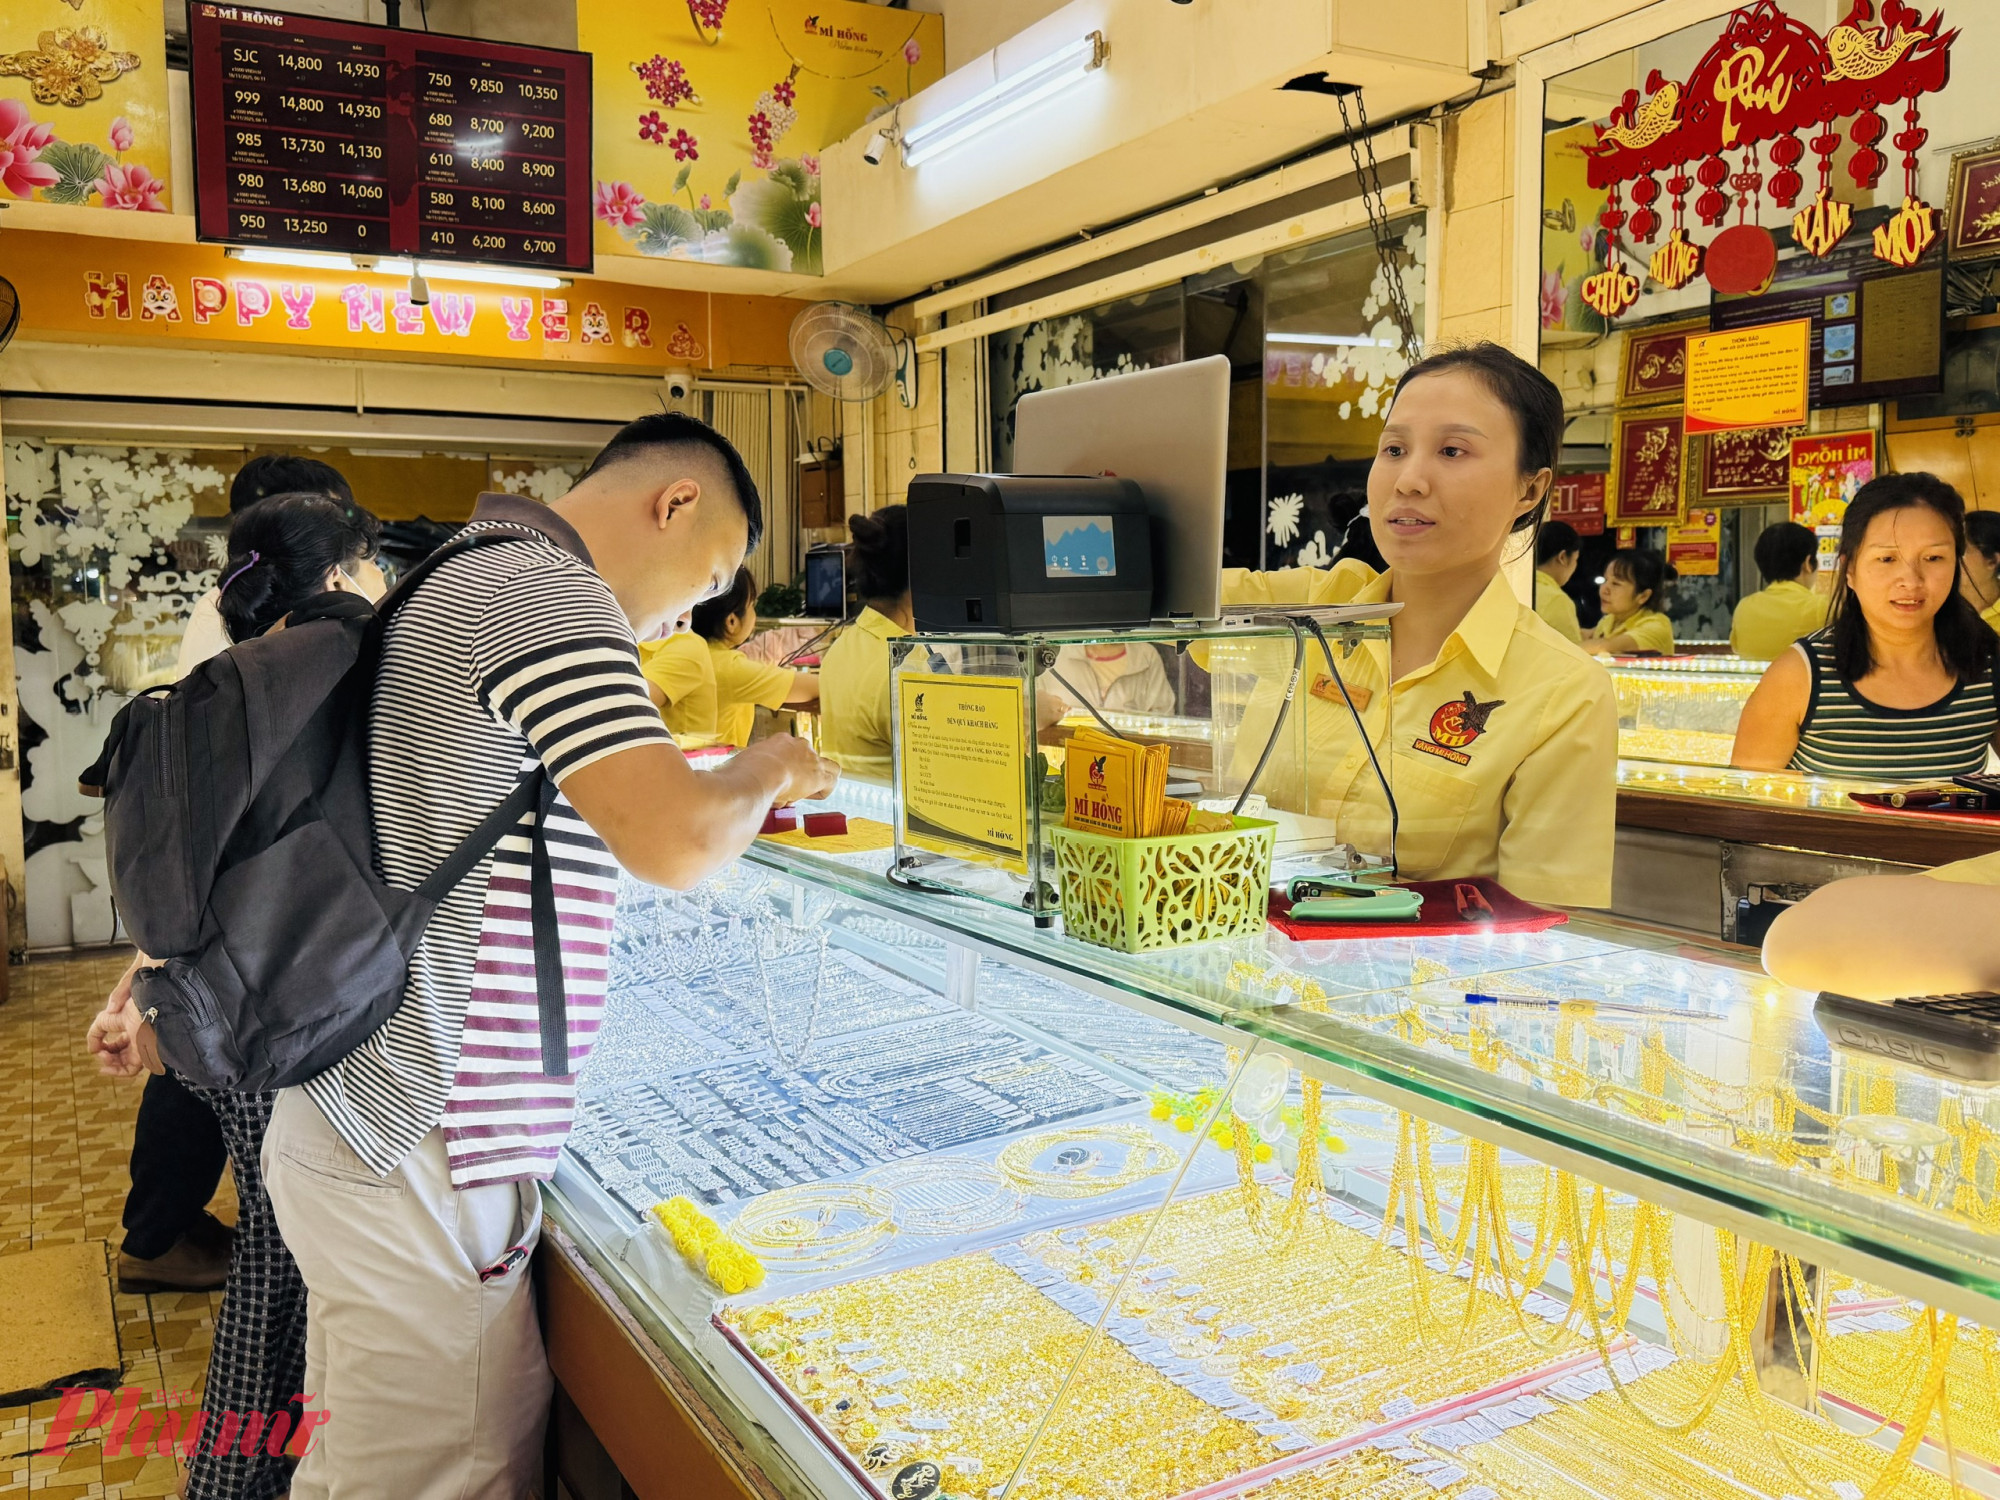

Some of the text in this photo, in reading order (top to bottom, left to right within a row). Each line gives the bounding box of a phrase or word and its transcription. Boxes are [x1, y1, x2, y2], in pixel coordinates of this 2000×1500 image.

[233, 48, 380, 78] SJC 14,800 14,930
[428, 72, 452, 87] 750
[469, 78, 504, 94] 9,850
[518, 84, 558, 101] 10,350
[234, 90, 381, 119] 999 14,800 14,930
[428, 113, 555, 139] 680 8,700 9,200
[236, 132, 382, 160] 985 13,730 14,130
[429, 153, 555, 178] 610 8,400 8,900
[238, 173, 383, 199] 980 13,680 14,060
[430, 192, 556, 216] 580 8,100 8,600
[239, 214, 367, 237] 950 13,250 0
[431, 231, 556, 254] 410 6,200 6,700
[1581, 187, 1935, 316] CHÚC MỪNG NĂM MỚI
[84, 271, 653, 348] HAPPY NEW YEAR
[1433, 725, 1469, 747] MH
[1091, 793, 1122, 824] HỒNG
[1838, 1024, 1950, 1069] CASIO
